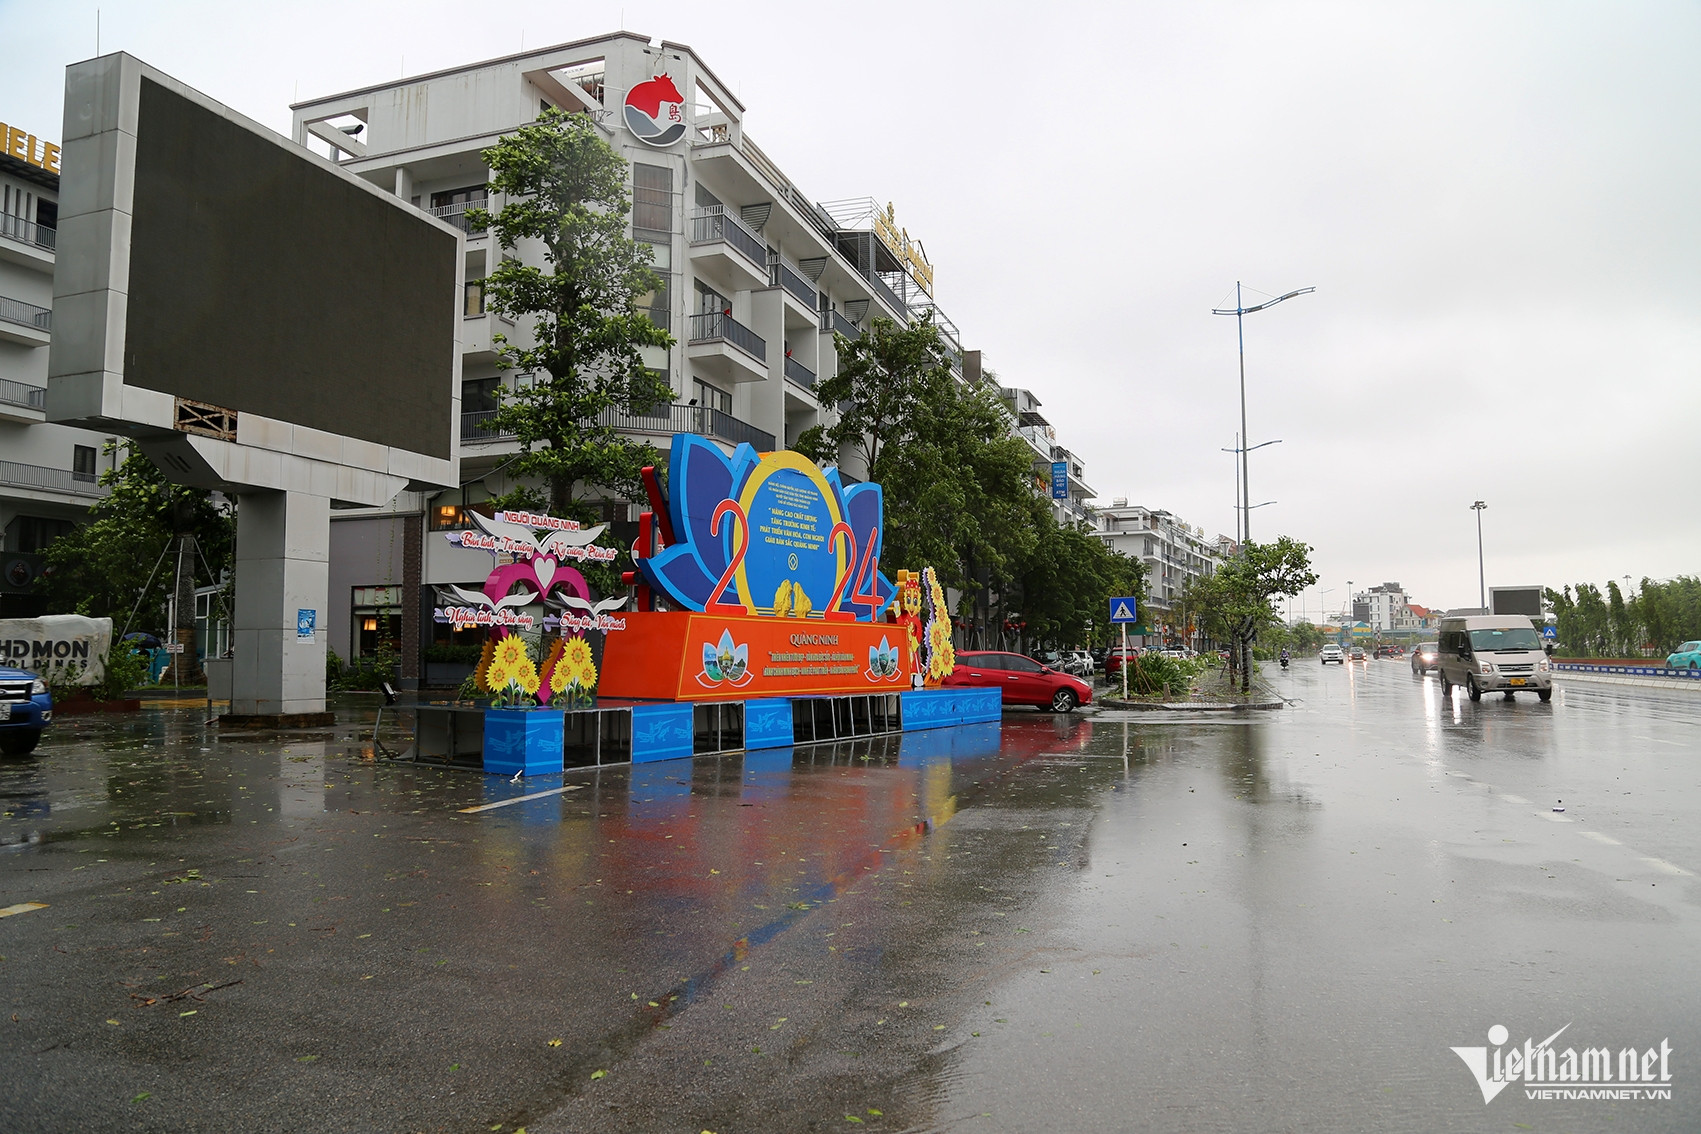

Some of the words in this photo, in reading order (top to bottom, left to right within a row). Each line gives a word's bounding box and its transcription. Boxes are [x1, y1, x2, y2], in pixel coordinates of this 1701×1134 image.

[560, 519, 579, 531] NINH
[789, 631, 818, 646] QUẢNG
[818, 634, 839, 646] NINH
